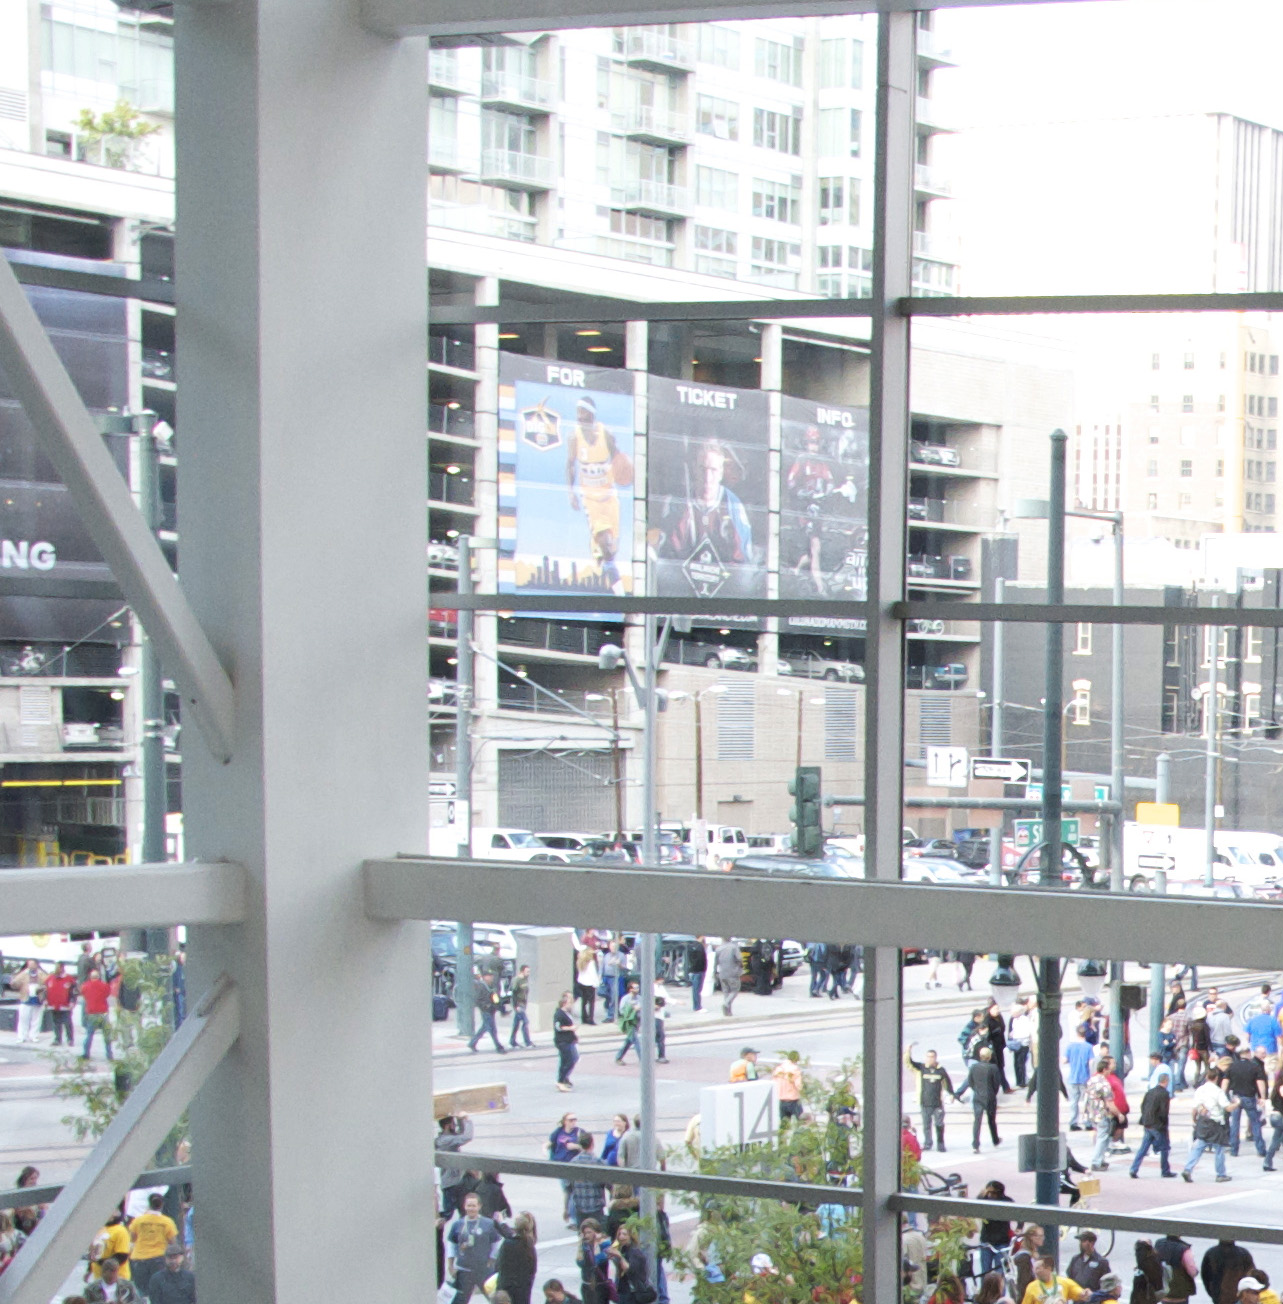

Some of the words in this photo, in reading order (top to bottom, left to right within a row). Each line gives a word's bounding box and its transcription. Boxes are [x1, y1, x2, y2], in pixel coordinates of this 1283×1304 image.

[547, 365, 586, 387] FOR
[676, 386, 738, 409] TICKET
[817, 407, 854, 427] INFO
[733, 1086, 778, 1152] 14
